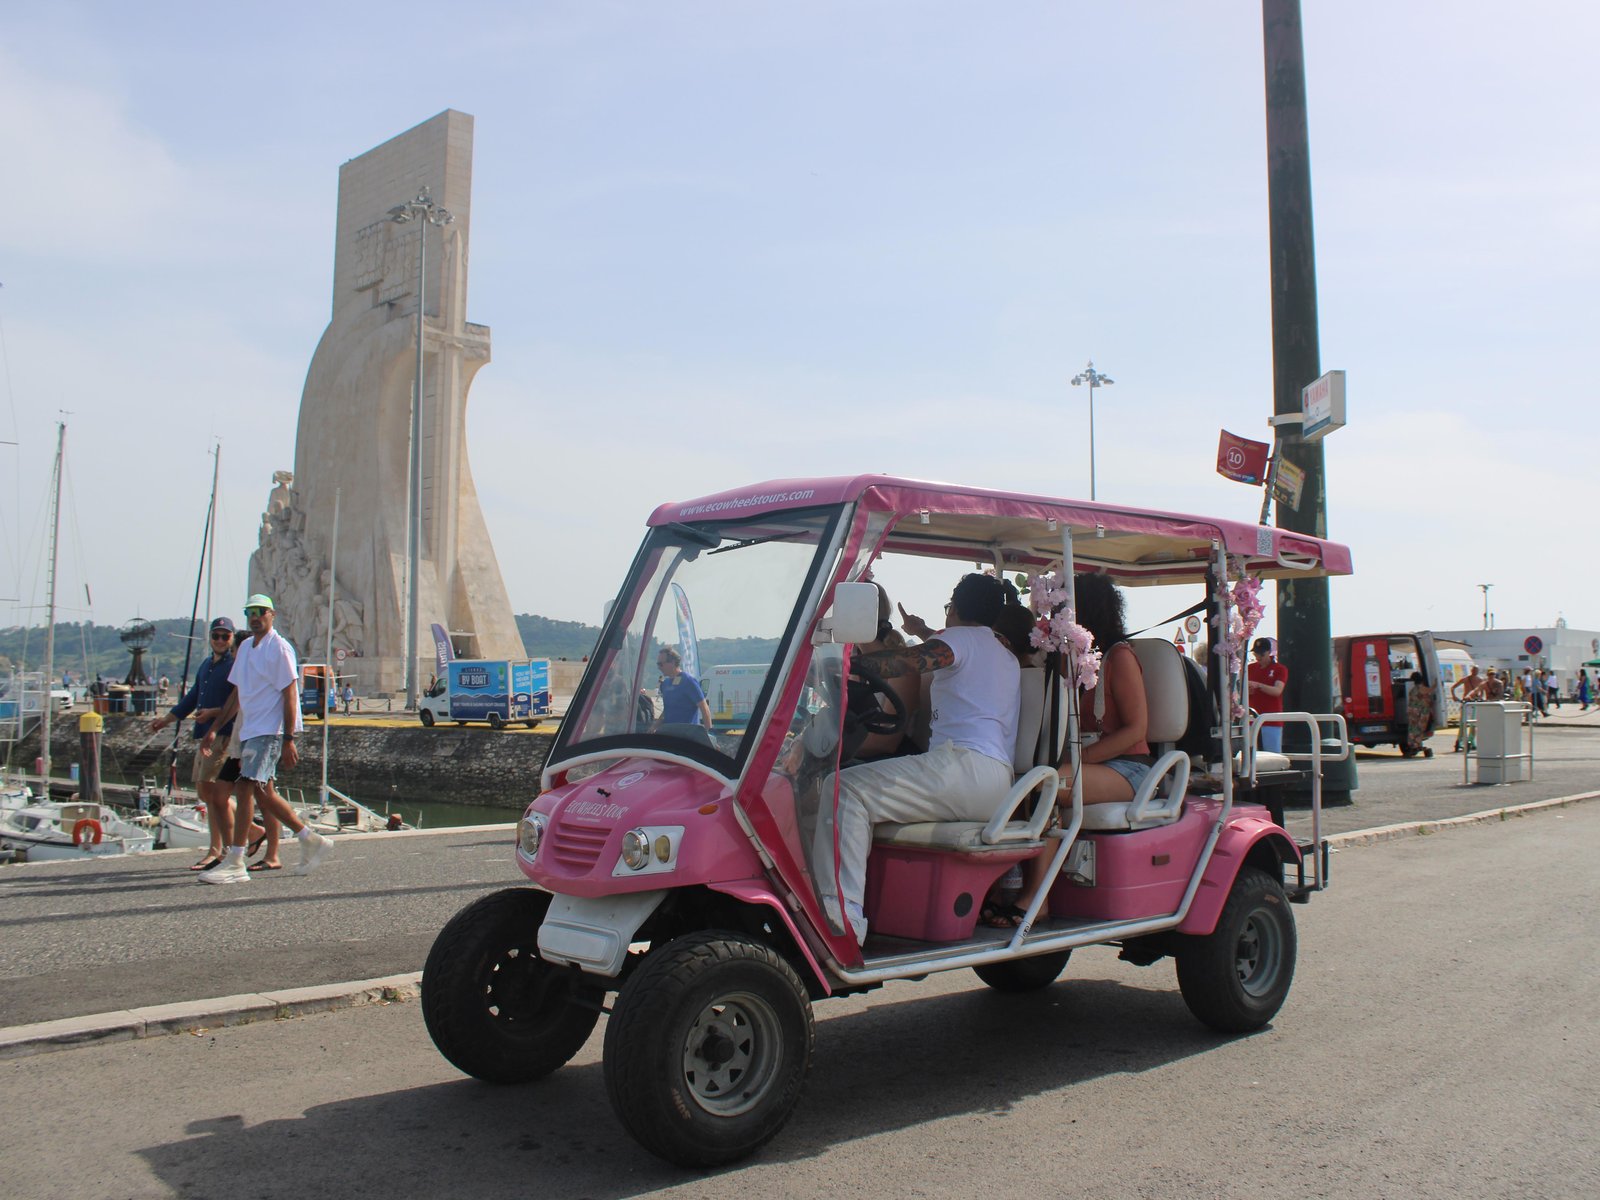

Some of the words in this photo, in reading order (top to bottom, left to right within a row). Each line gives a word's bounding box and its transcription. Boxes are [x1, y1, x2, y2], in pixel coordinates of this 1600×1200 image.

[1229, 451, 1241, 464] 10
[680, 490, 814, 516] www.ecowheelstours.com
[461, 675, 470, 684] BY
[471, 675, 487, 684] BOAT
